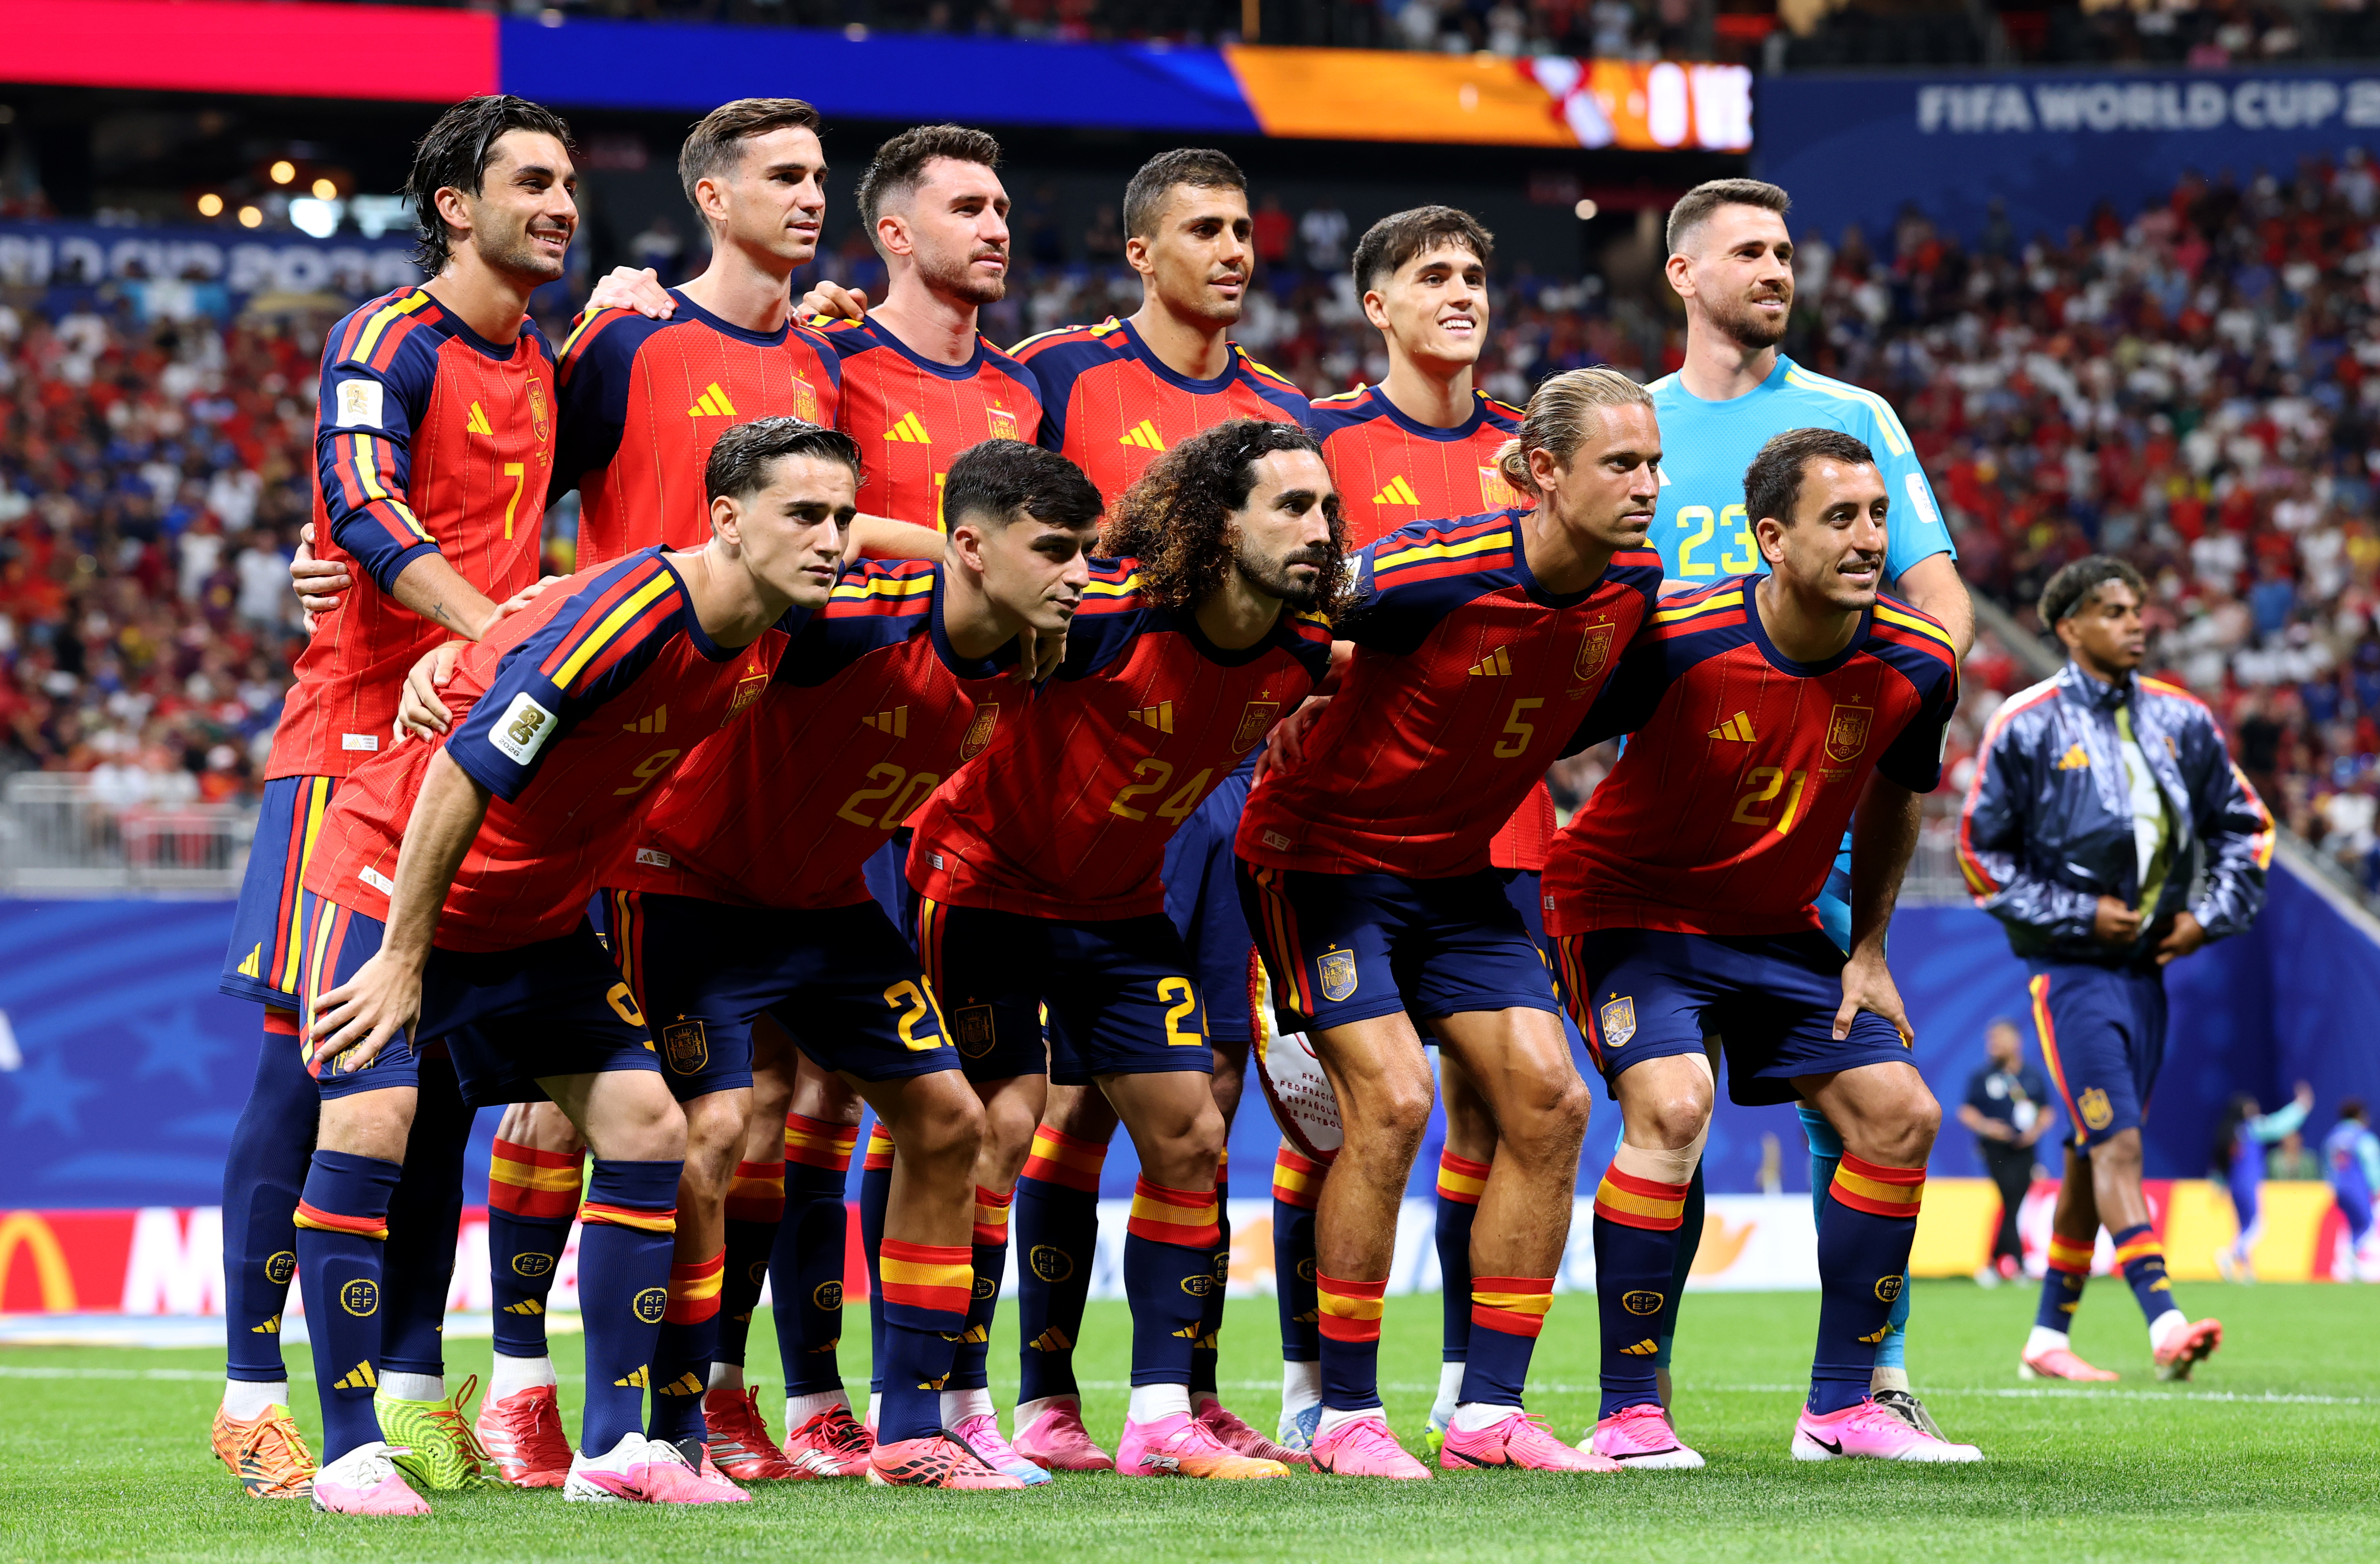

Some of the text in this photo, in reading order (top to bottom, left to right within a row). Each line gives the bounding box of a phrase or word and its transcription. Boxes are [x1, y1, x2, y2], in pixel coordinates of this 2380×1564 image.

[1918, 84, 2033, 134] FIFA
[2035, 82, 2227, 132] WORLD
[2231, 81, 2340, 130] CUP
[504, 462, 524, 540] 7
[935, 473, 947, 534] 1
[1676, 504, 1758, 576] 23
[1493, 698, 1545, 758] 5
[498, 738, 520, 756] 2026
[502, 735, 515, 746] WORLD
[612, 749, 680, 795] 9
[836, 763, 940, 830] 20
[1108, 758, 1213, 826] 24
[1732, 766, 1807, 835] 21
[1157, 977, 1209, 1046] 2
[1302, 1073, 1324, 1086] REAL
[1280, 1080, 1335, 1102] FEDERACIÓ
[1287, 1095, 1338, 1117] ESPAÑOLA
[1304, 1113, 1343, 1129] FÚTBOL
[276, 1258, 294, 1267] RF
[1039, 1252, 1059, 1263] RF
[274, 1268, 291, 1277] EF
[1040, 1262, 1059, 1274] EF
[351, 1287, 373, 1296] RF
[824, 1287, 840, 1295] RF
[351, 1298, 372, 1307] EF
[645, 1296, 664, 1304] RF
[823, 1296, 840, 1304] EF
[643, 1306, 662, 1315] EF
[1144, 1445, 1162, 1455] FUTURE
